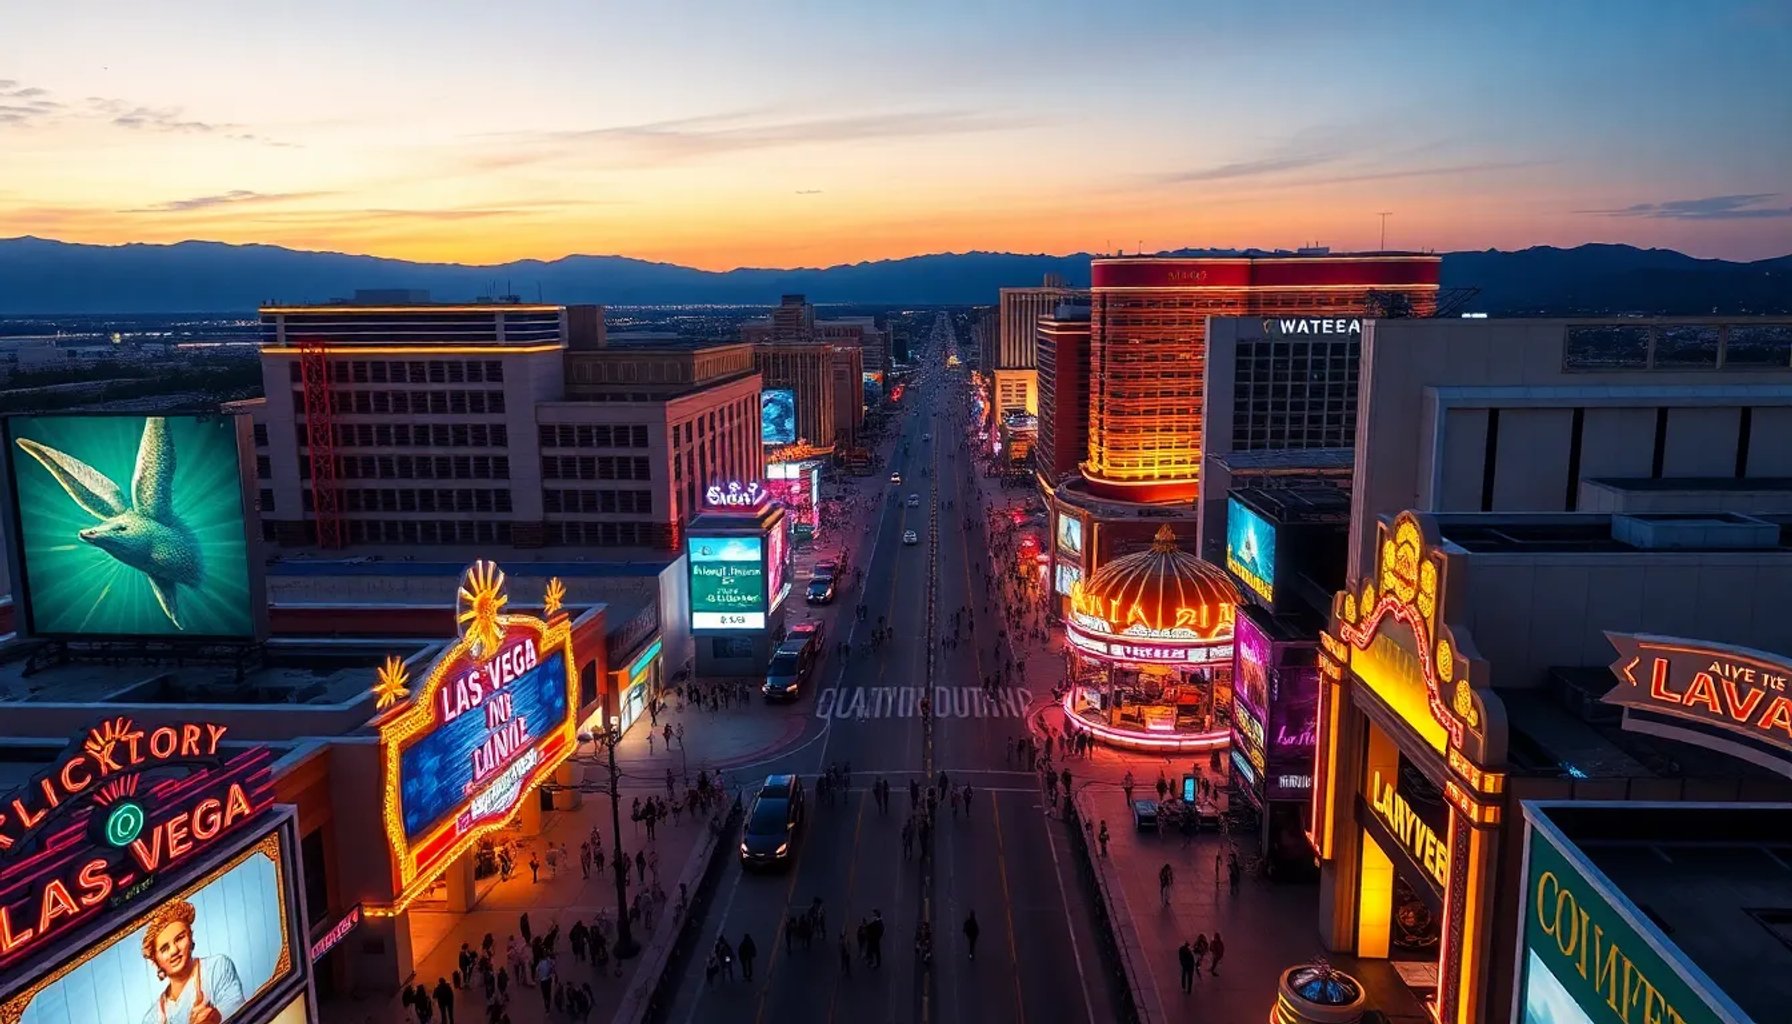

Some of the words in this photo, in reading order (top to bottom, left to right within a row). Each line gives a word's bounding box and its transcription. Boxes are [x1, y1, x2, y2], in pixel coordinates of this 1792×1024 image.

[1280, 318, 1361, 335] WATEEA
[441, 671, 483, 722] LAS
[486, 639, 537, 690] VEGA
